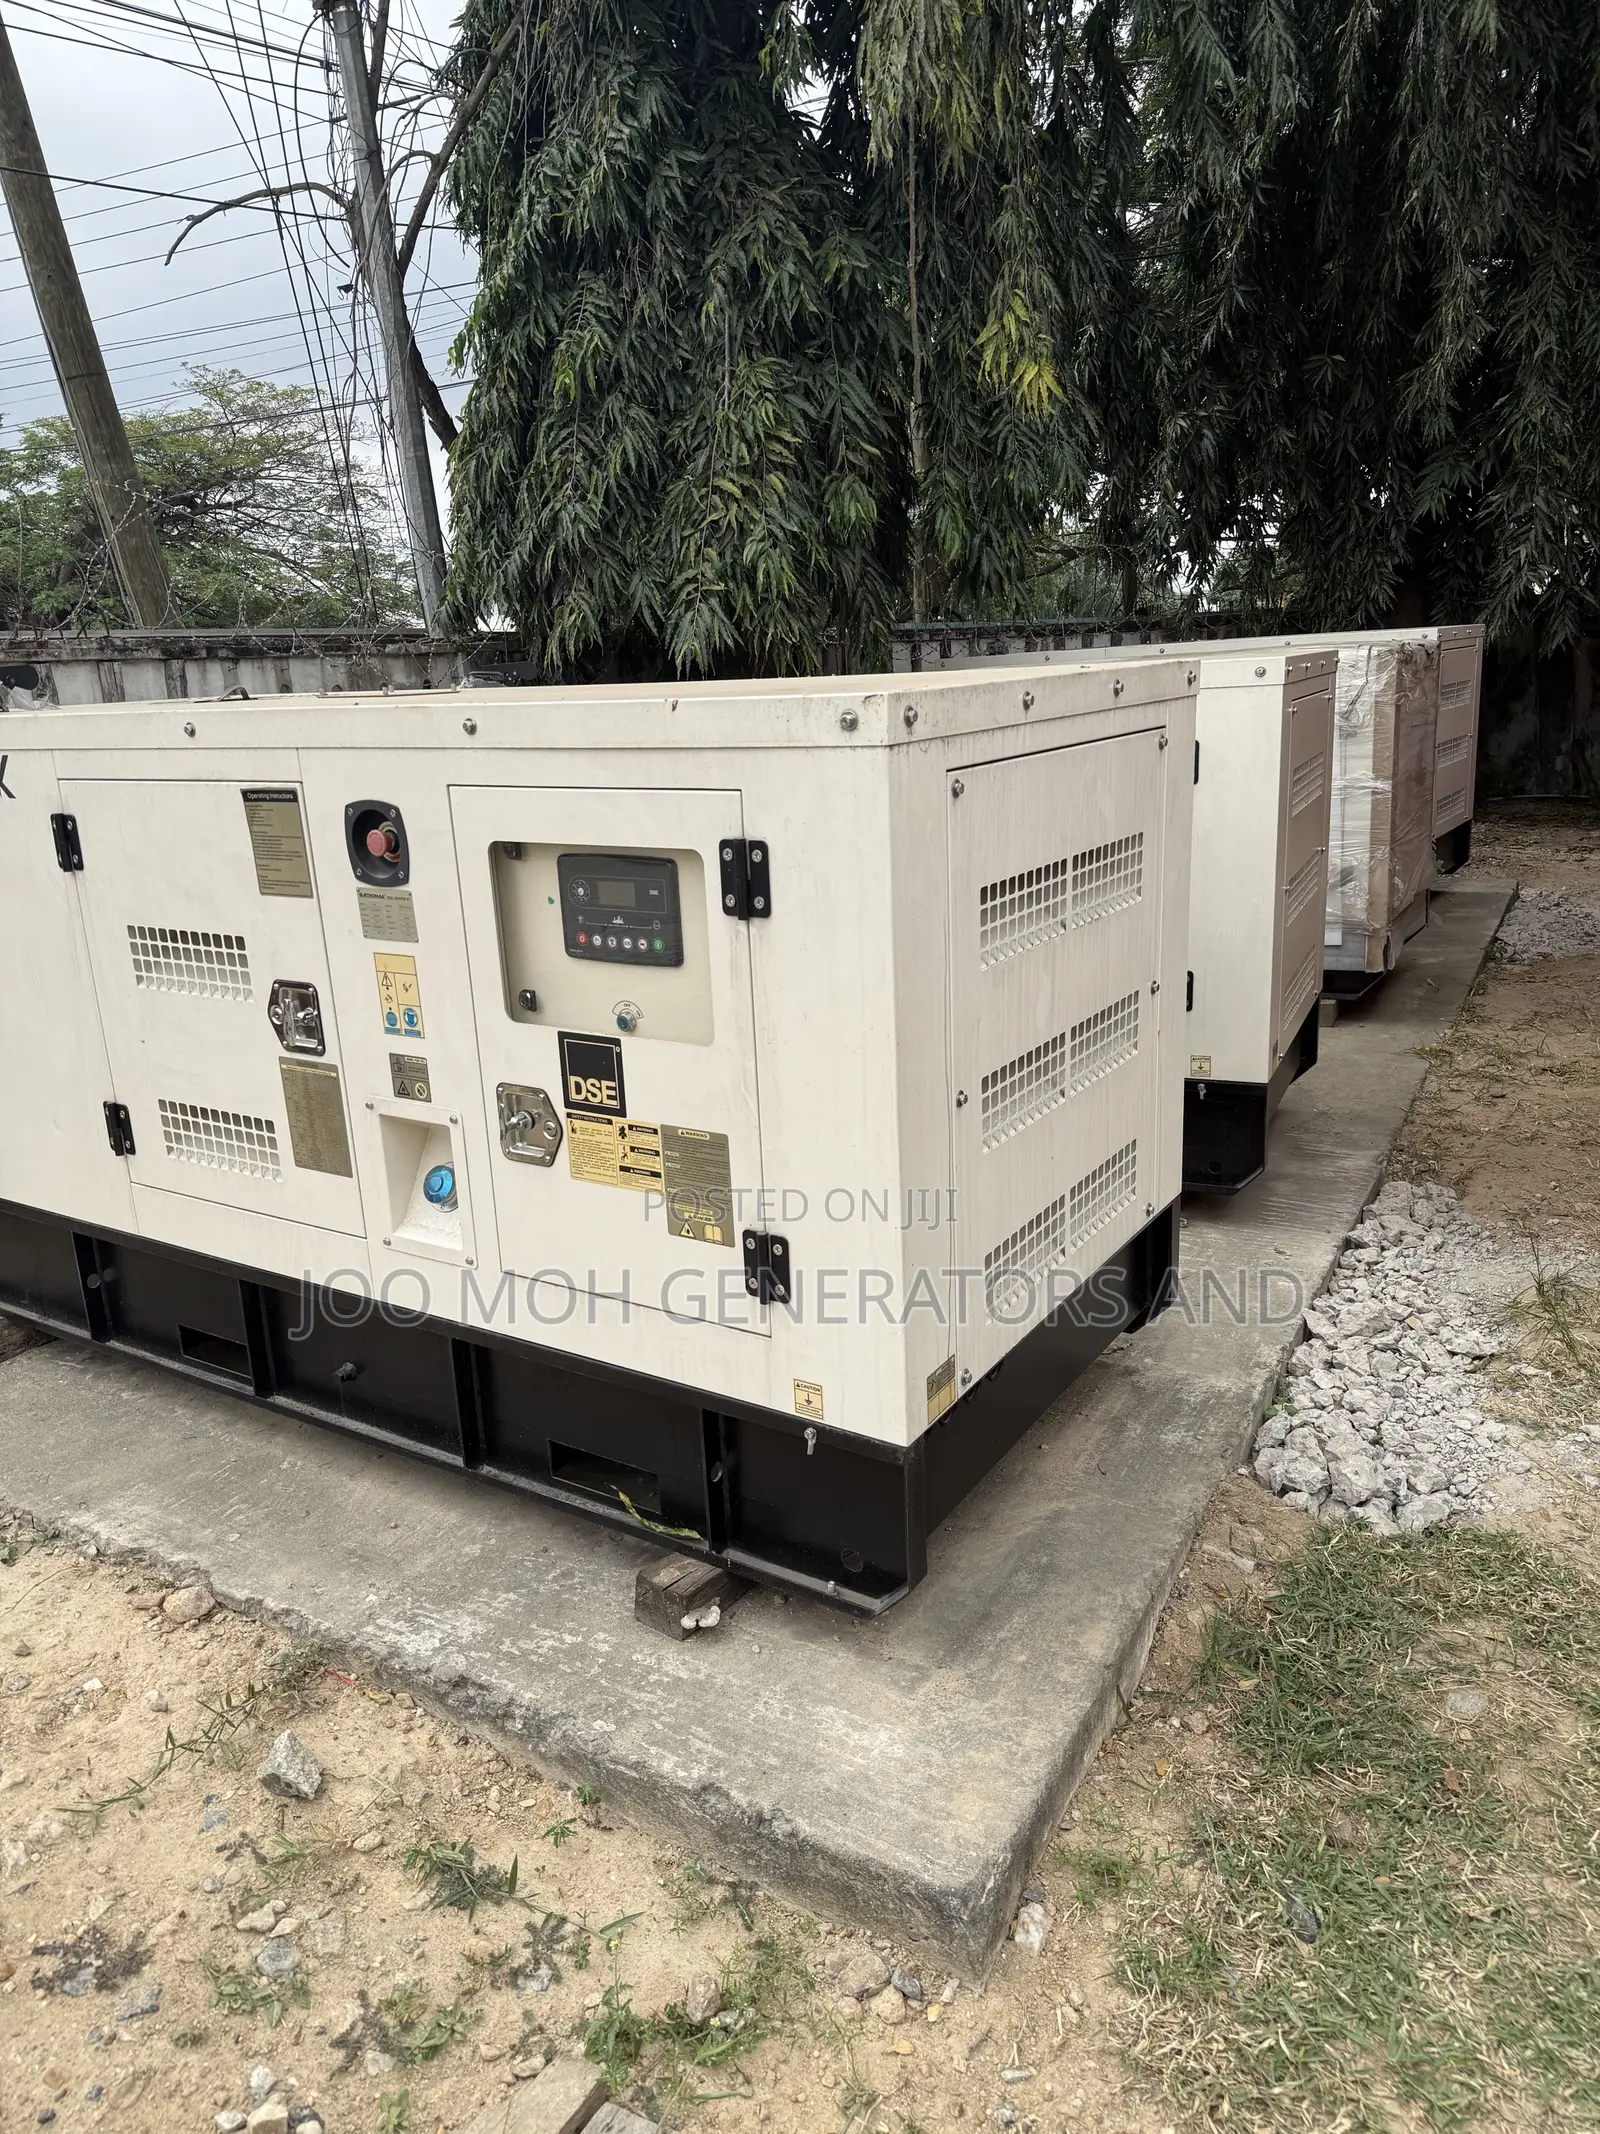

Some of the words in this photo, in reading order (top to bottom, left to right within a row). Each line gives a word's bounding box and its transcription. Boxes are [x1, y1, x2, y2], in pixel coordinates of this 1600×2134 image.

[247, 792, 270, 800] Operating
[569, 1075, 618, 1106] DSE
[685, 1130, 708, 1139] WARNING
[801, 1383, 821, 1392] CAUTION
